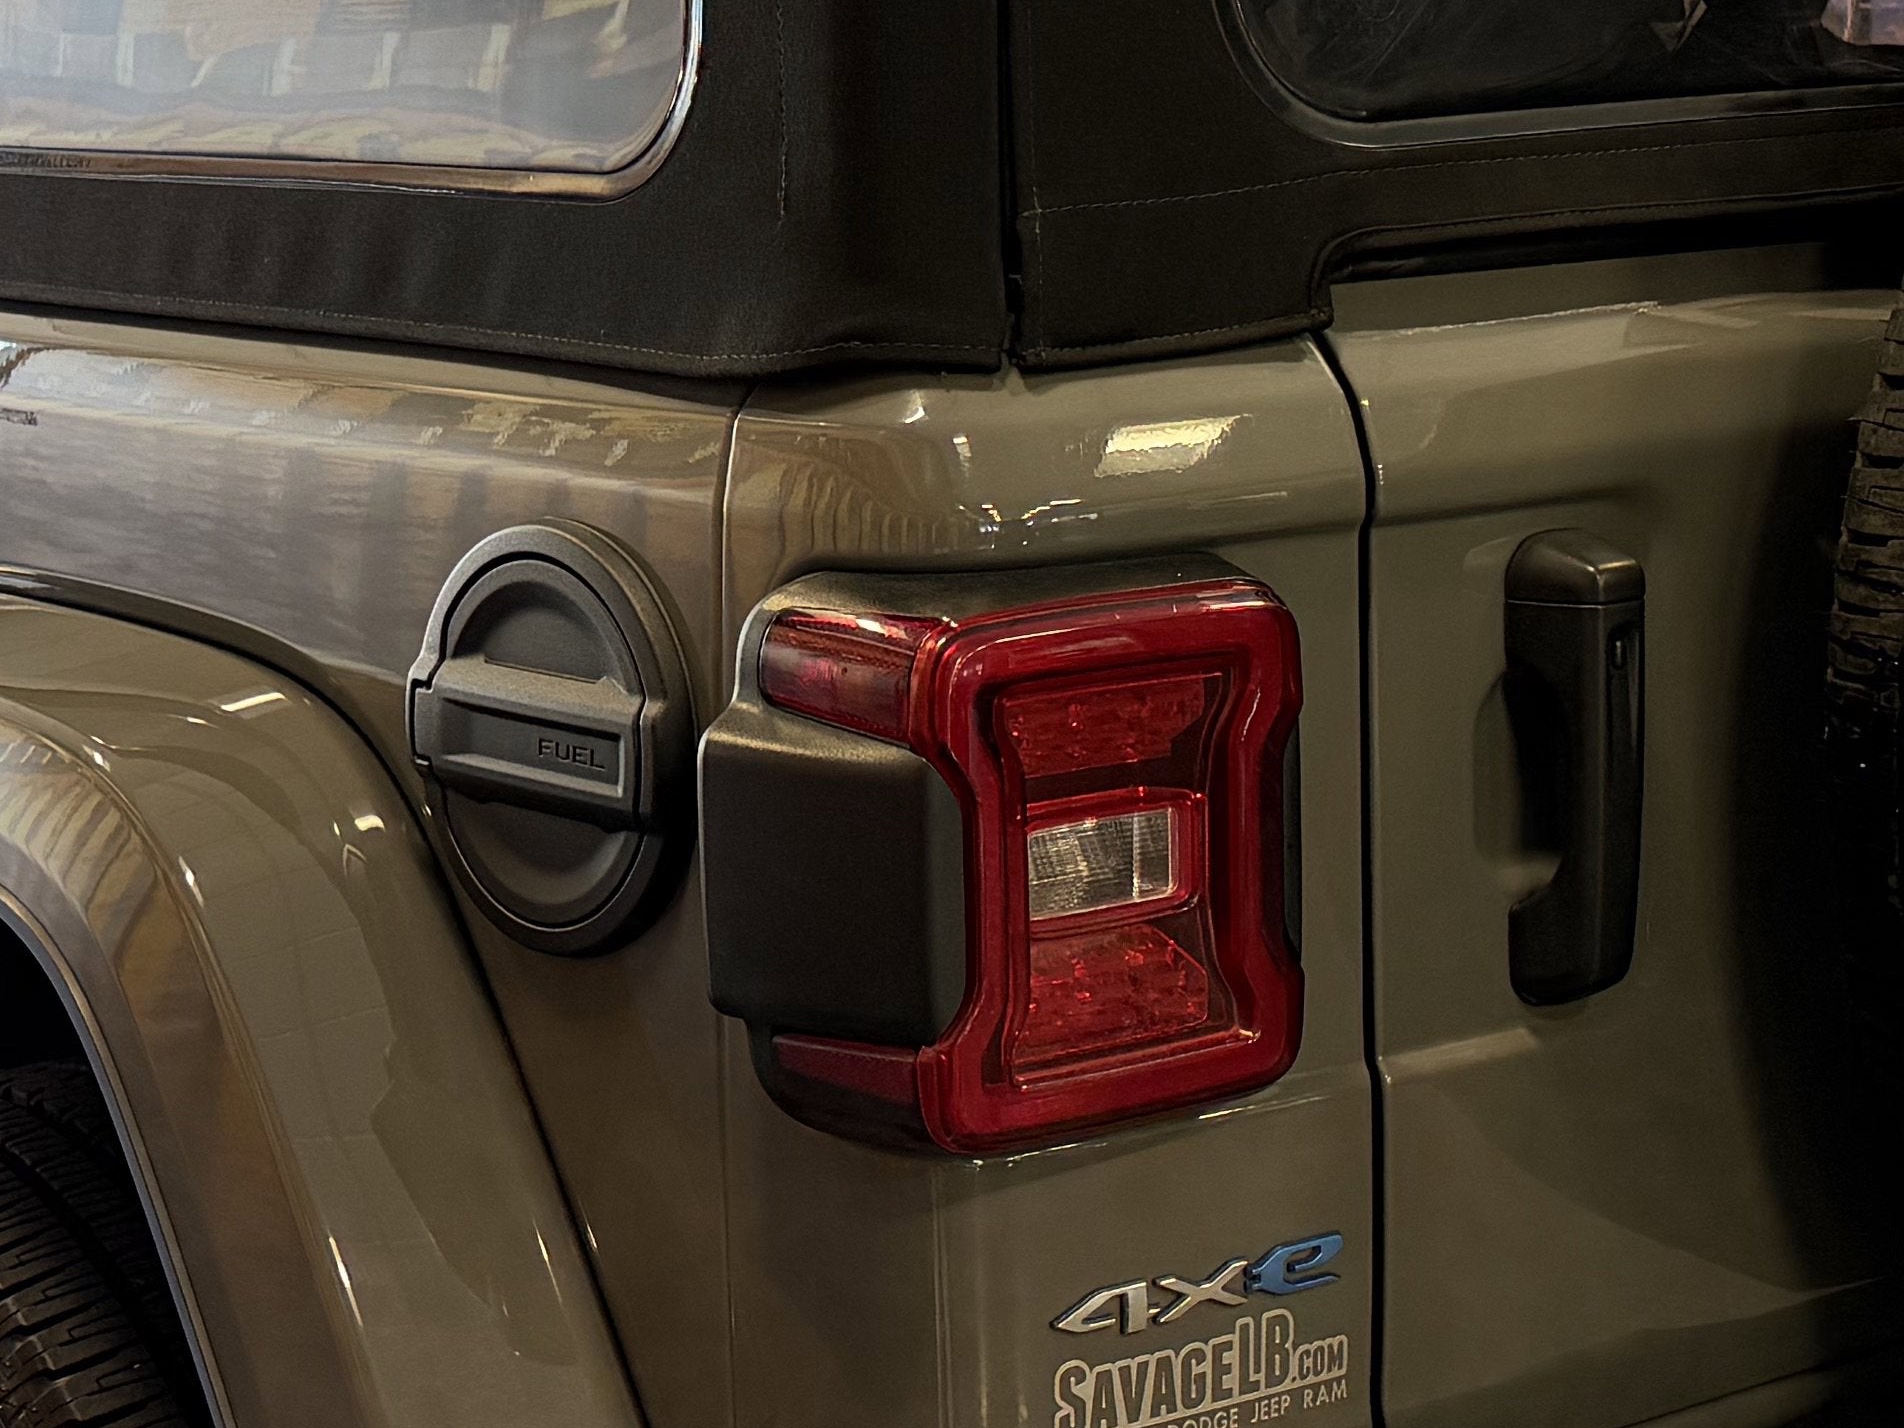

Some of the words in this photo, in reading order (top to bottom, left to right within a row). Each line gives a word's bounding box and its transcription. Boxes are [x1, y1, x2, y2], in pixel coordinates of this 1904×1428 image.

[536, 737, 607, 772] FUEL
[1250, 1394, 1291, 1424] JEEP
[1303, 1379, 1348, 1410] RAM
